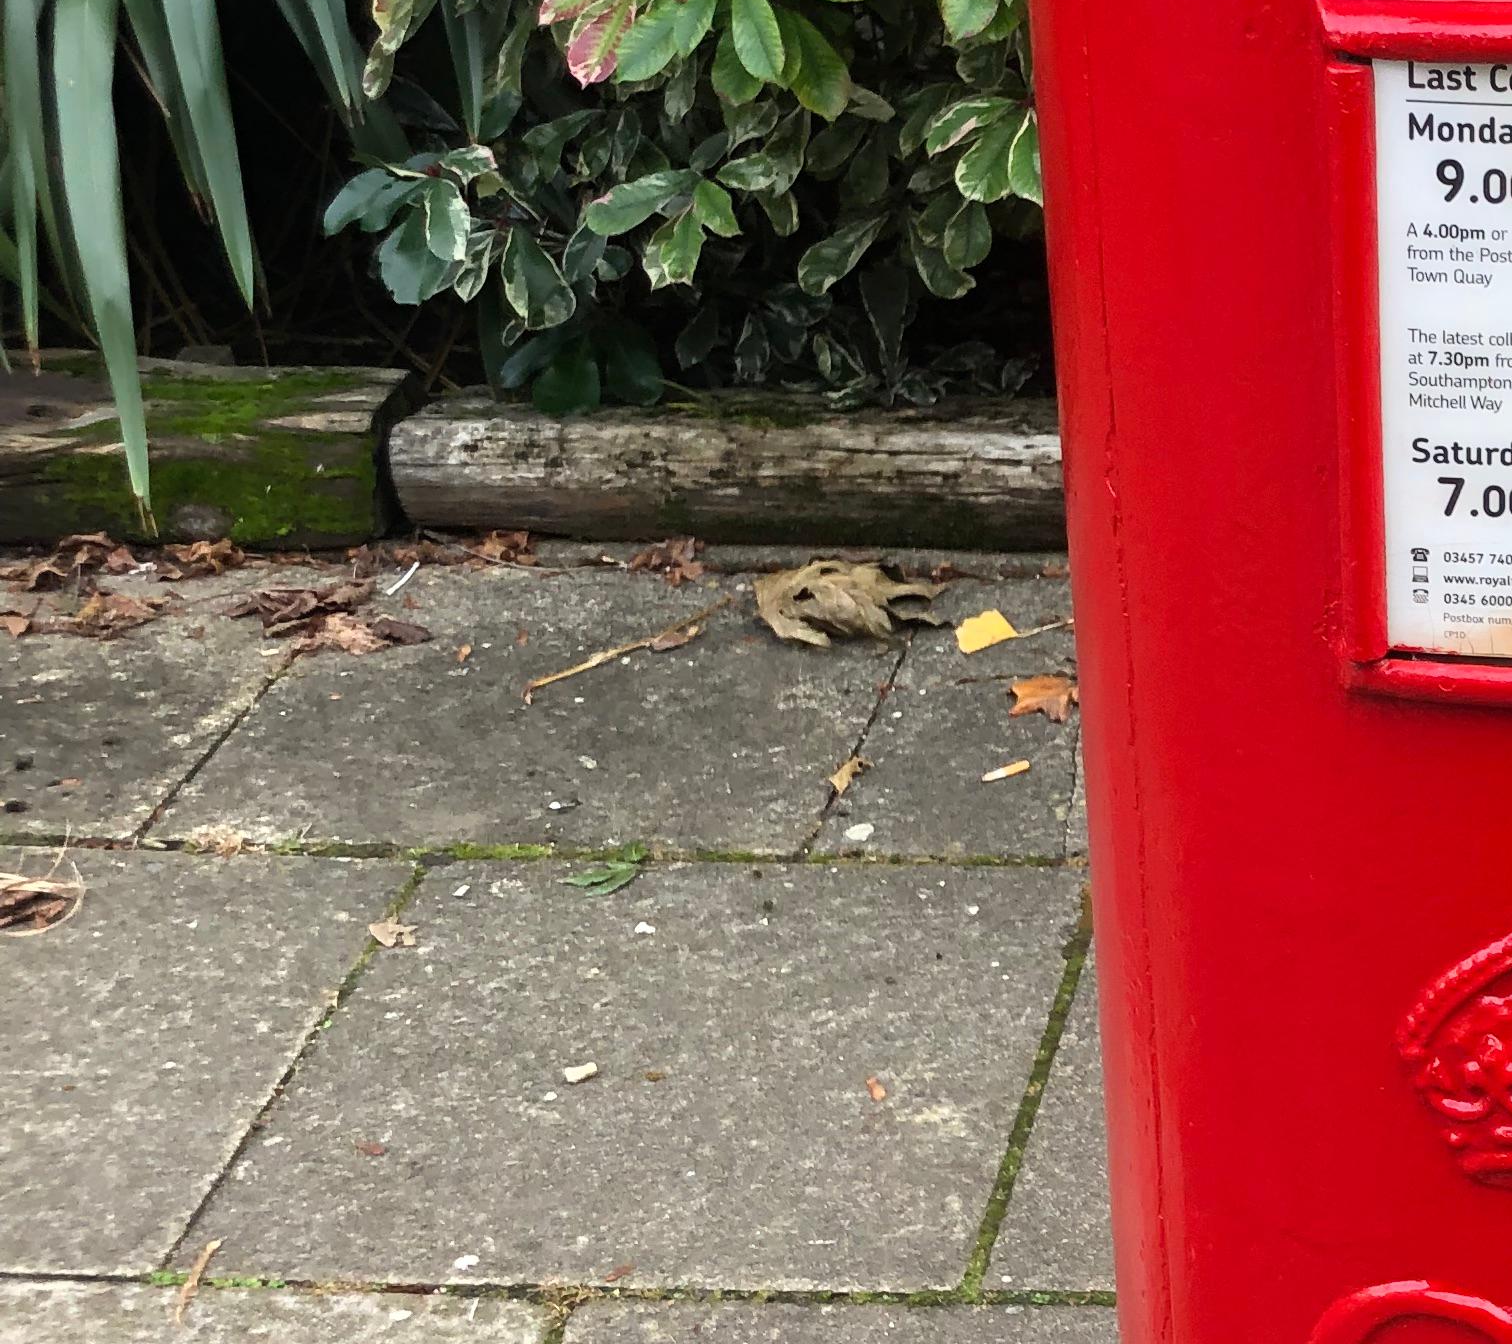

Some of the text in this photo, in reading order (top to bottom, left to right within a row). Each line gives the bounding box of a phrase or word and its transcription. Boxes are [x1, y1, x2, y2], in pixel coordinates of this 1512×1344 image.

[1407, 61, 1477, 92] Last
[1407, 223, 1417, 237] A
[1423, 224, 1485, 242] 4.00pm
[1491, 230, 1508, 241] or
[1407, 245, 1443, 260] from
[1449, 247, 1474, 262] the
[1408, 267, 1492, 288] Town Quay
[1408, 328, 1436, 344] The
[1443, 330, 1483, 345] latest
[1409, 352, 1423, 364] at
[1428, 351, 1489, 369] 7.30pm
[1409, 372, 1512, 391] Southampton
[1410, 393, 1502, 413] Mitchell Way
[1444, 552, 1483, 564] 03457
[1444, 593, 1475, 605] 0345
[1444, 612, 1484, 624] Postbox
